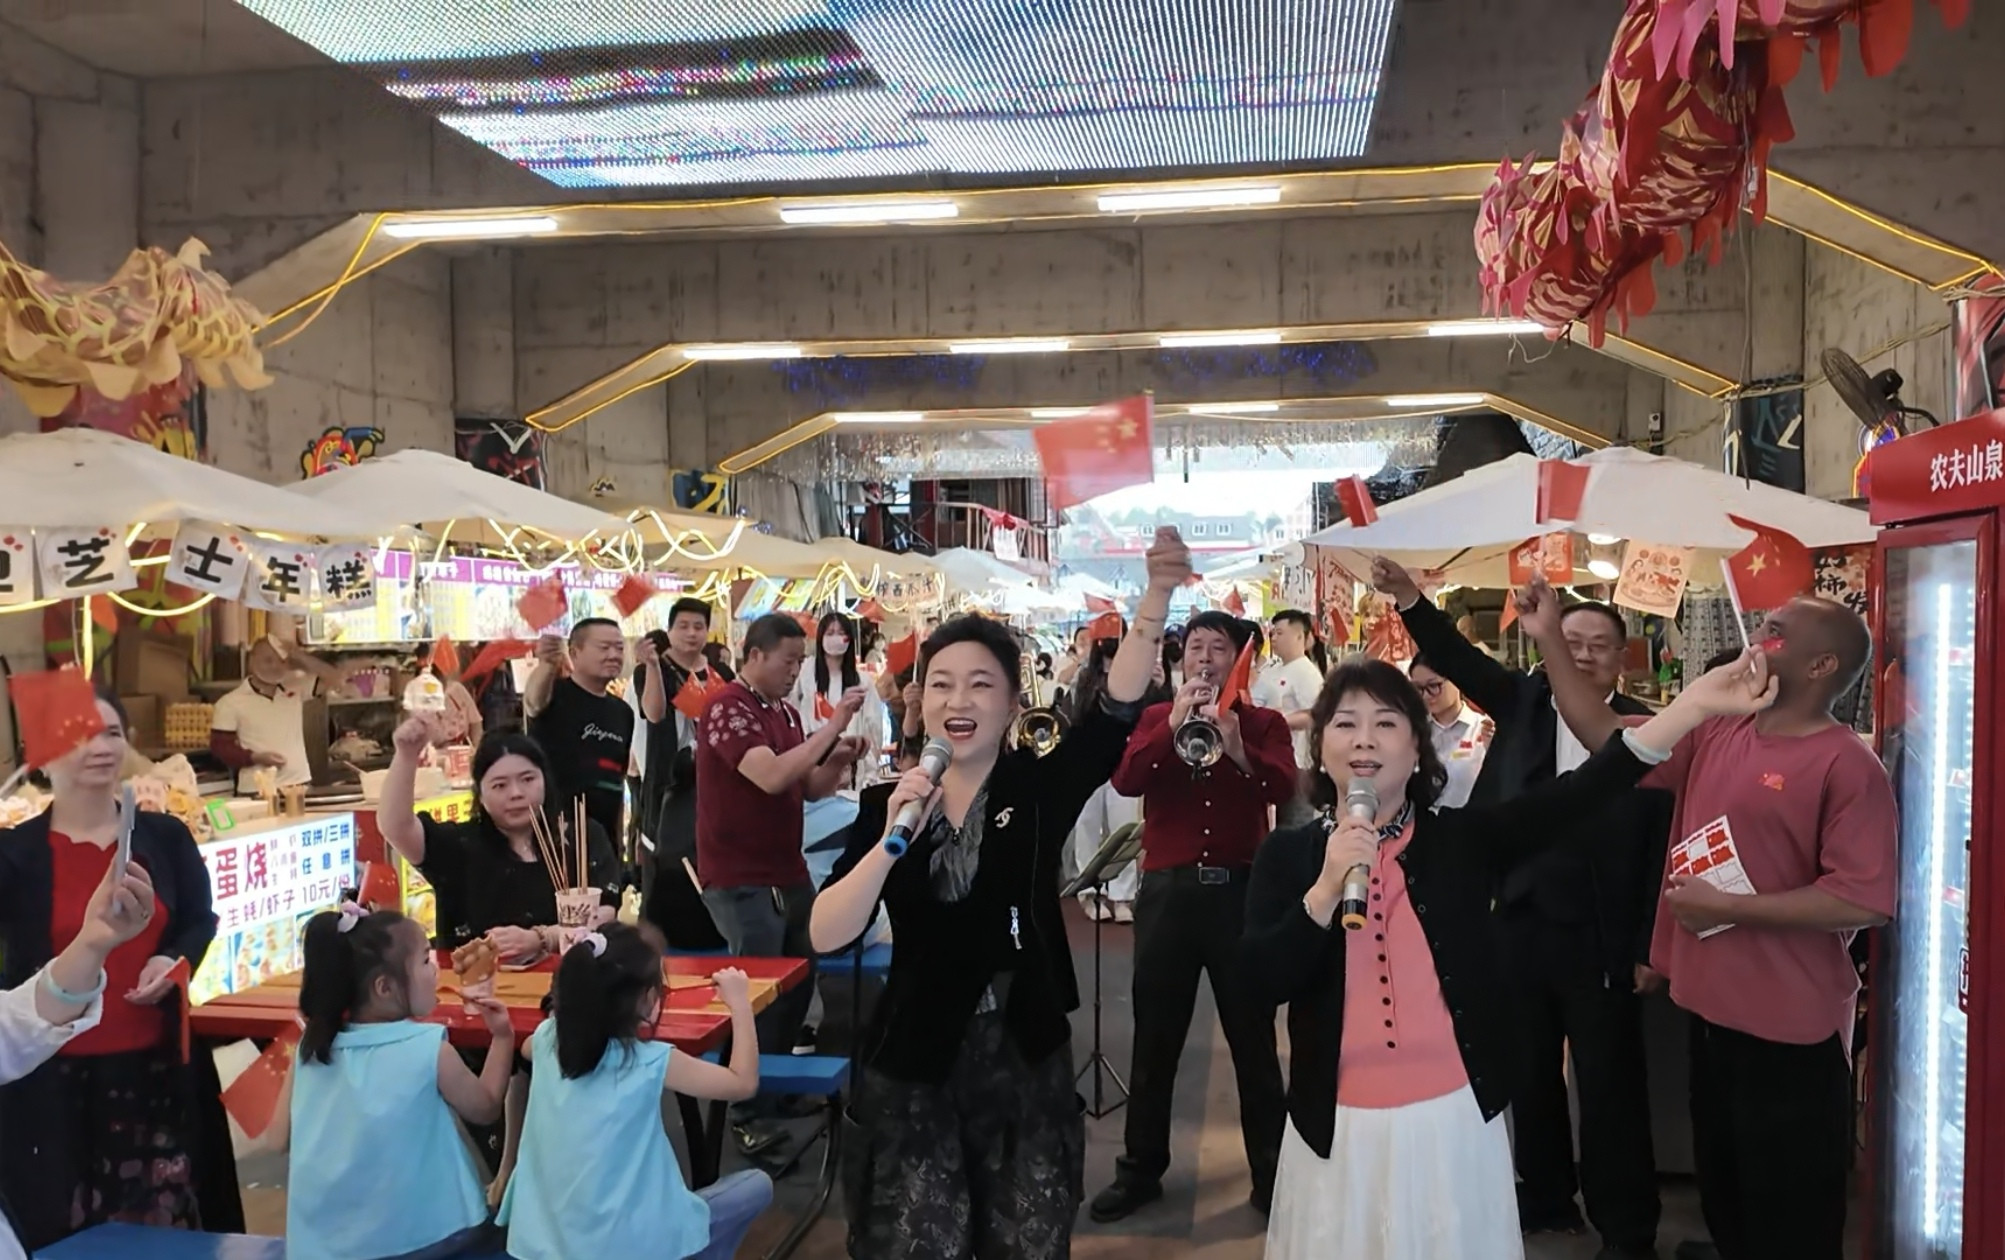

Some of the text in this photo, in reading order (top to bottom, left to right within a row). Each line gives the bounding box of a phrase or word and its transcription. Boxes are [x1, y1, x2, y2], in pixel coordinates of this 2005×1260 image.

[1930, 439, 2004, 492] 农夫山泉
[198, 842, 268, 900] 蛋烧
